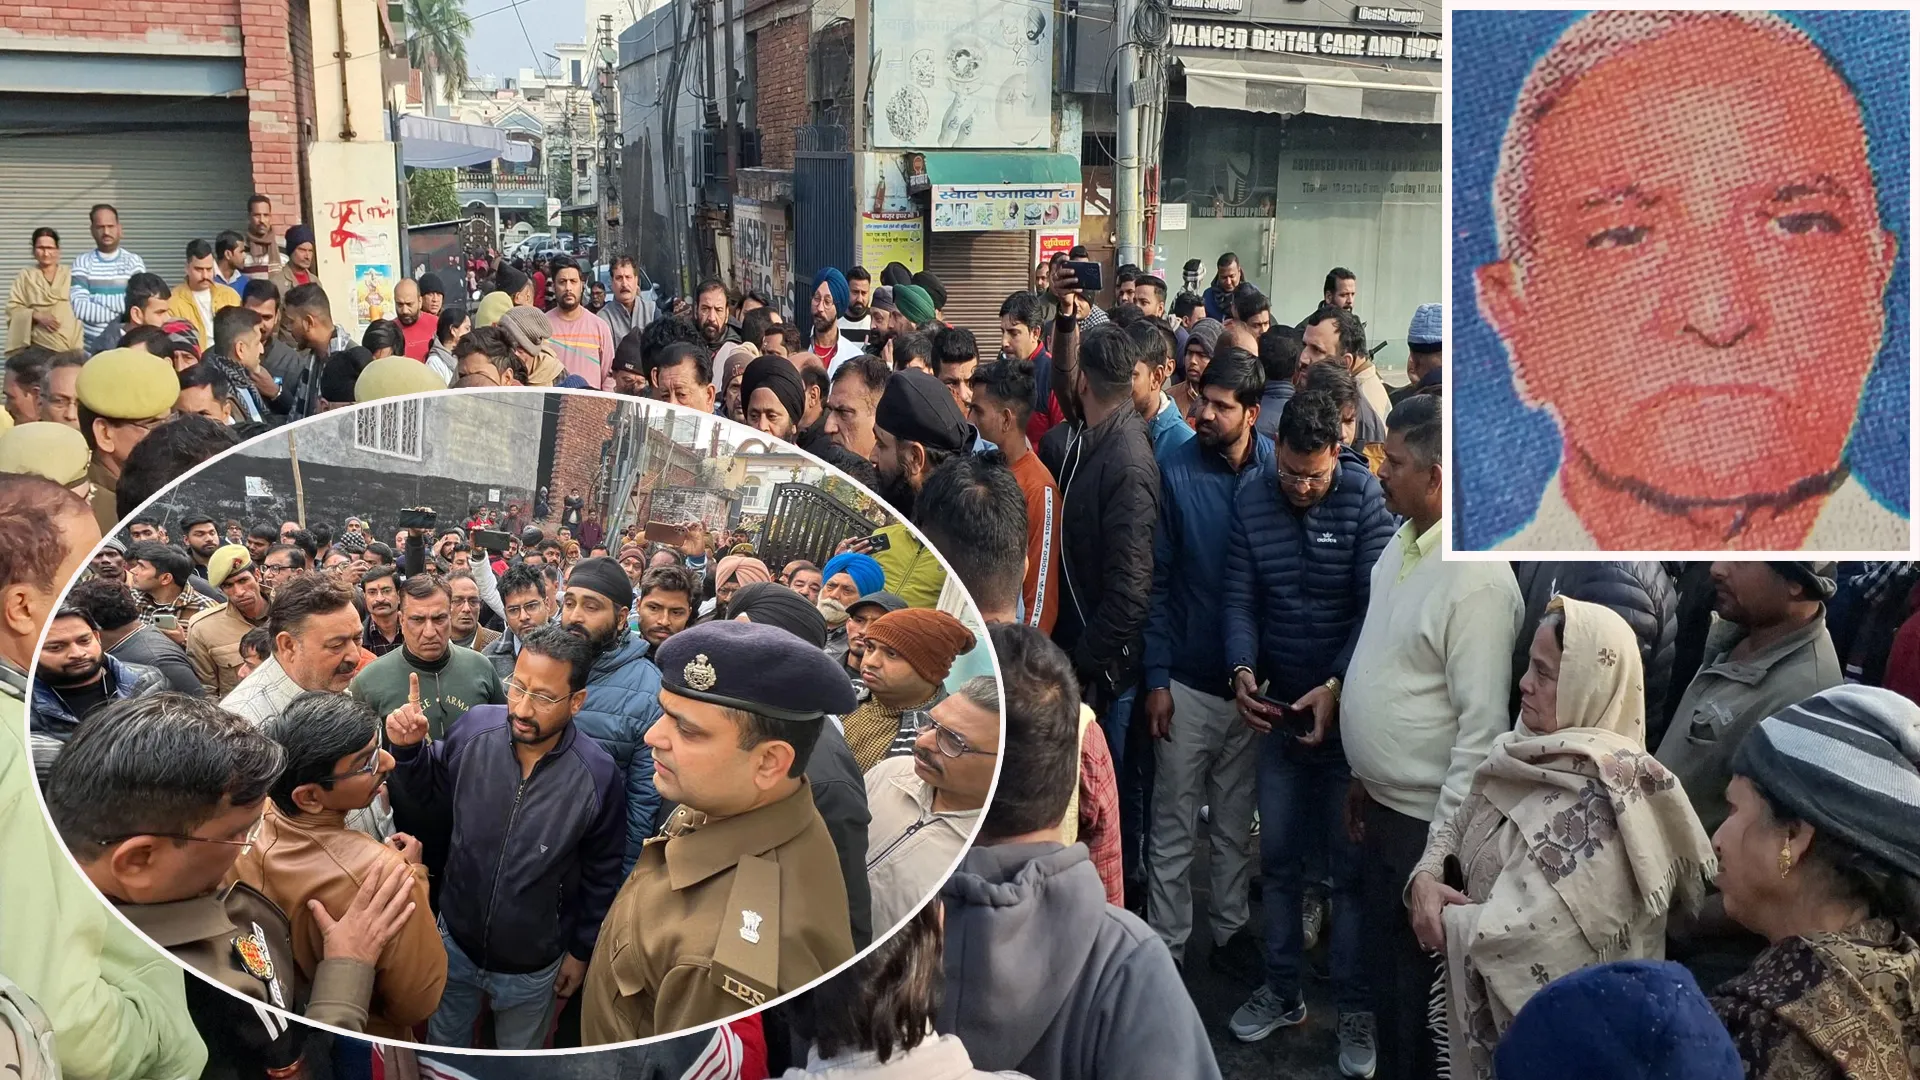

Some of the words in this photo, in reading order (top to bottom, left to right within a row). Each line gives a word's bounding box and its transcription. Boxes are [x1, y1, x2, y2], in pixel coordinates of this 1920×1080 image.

[1251, 29, 1318, 53] DENTAL
[1320, 32, 1366, 55] CARE
[1368, 35, 1403, 57] AND
[1198, 207, 1215, 217] YOUR
[1236, 207, 1249, 217] OUR
